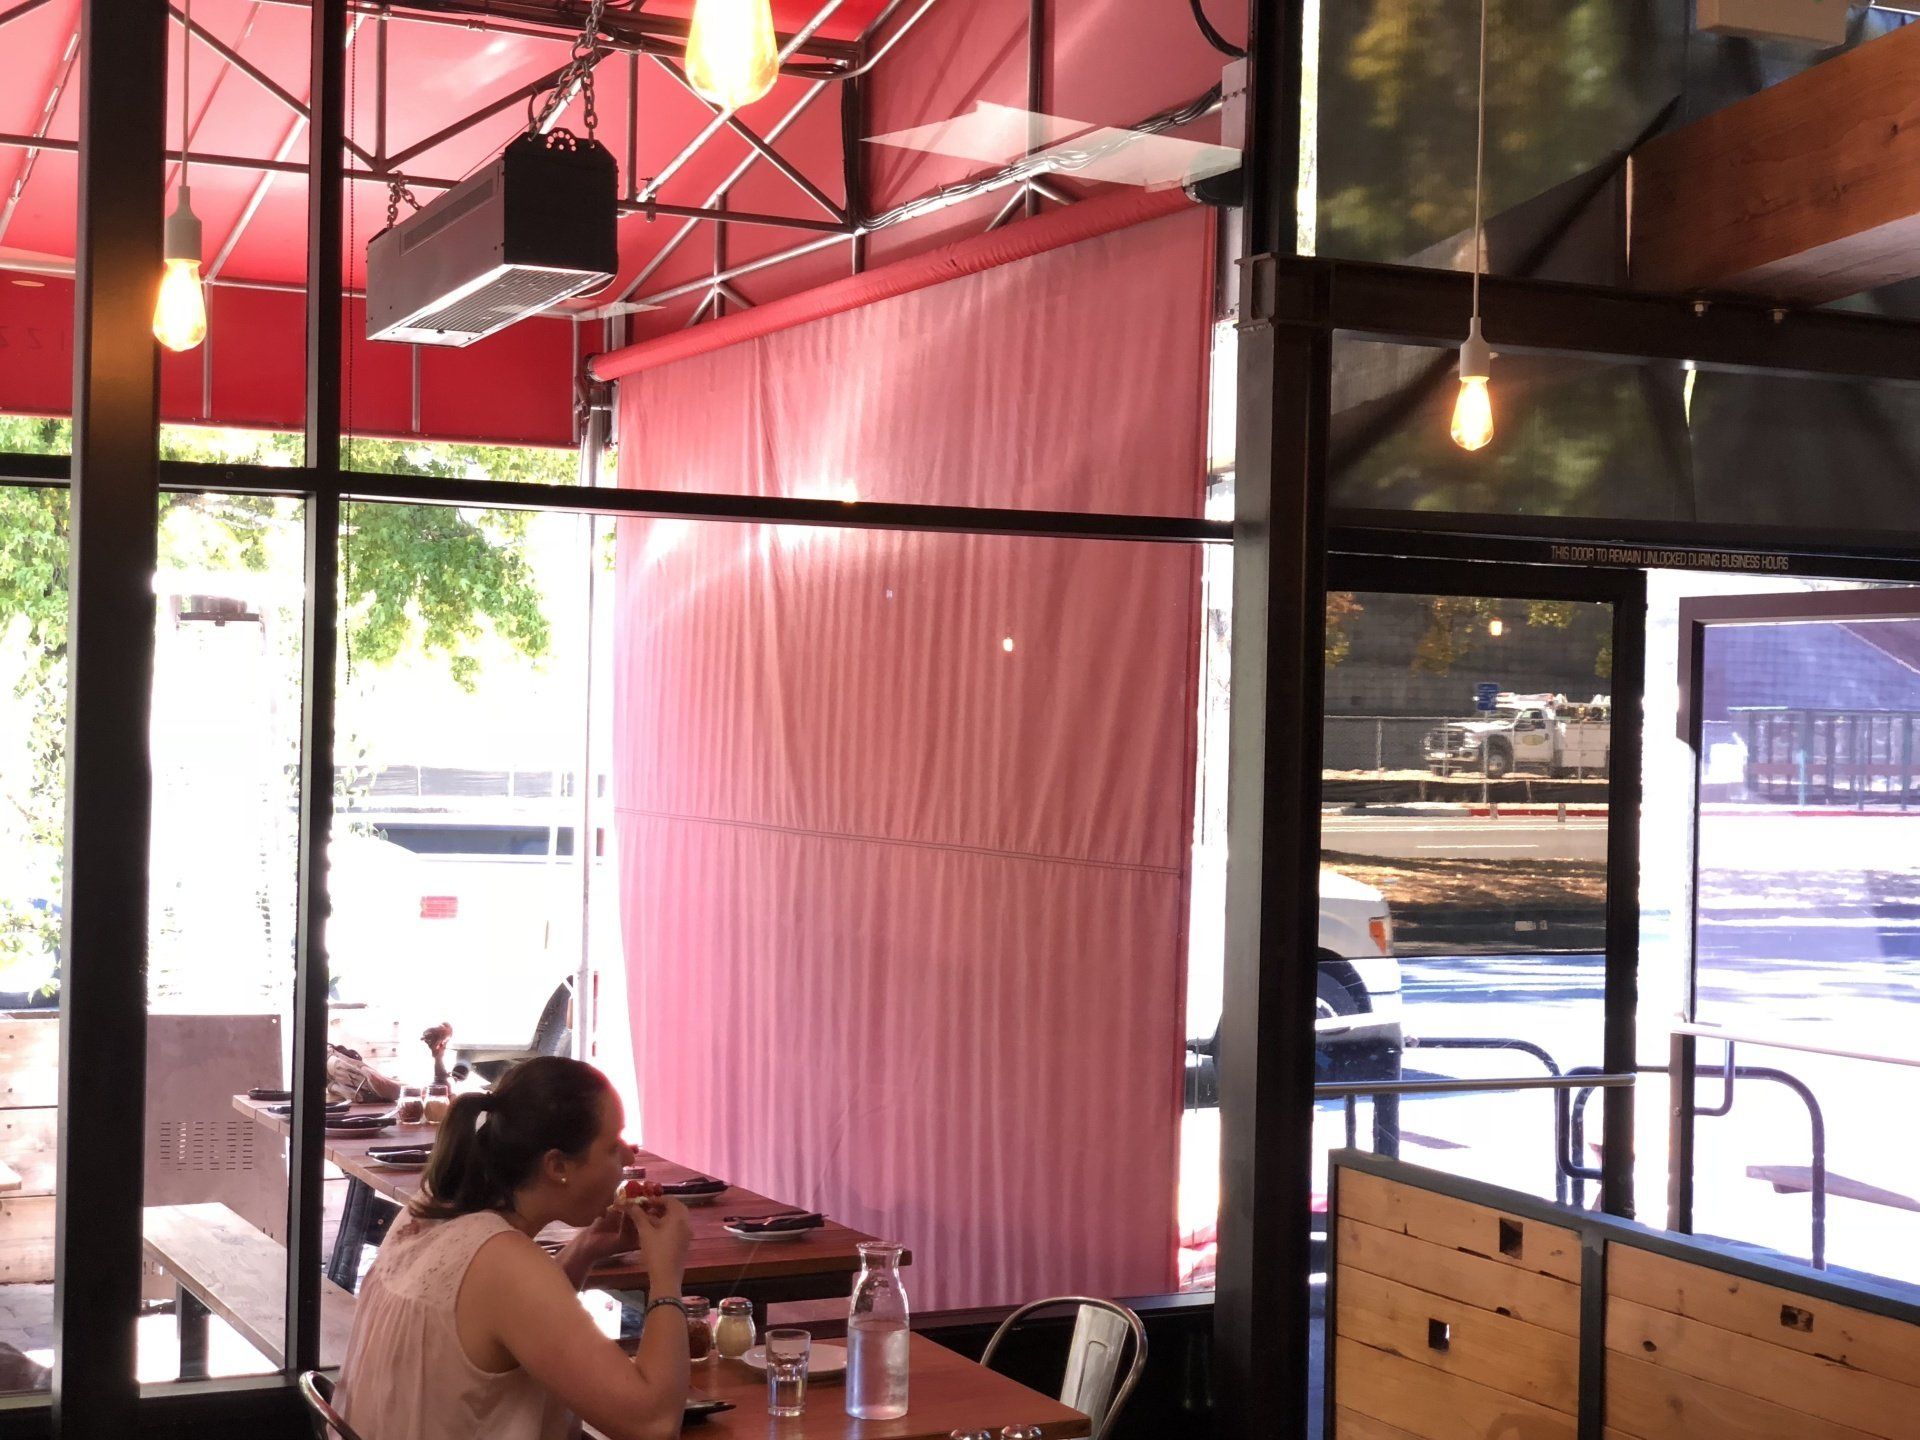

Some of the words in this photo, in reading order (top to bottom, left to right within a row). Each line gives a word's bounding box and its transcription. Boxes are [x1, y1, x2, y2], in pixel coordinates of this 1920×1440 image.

[1551, 545, 1569, 560] THIS
[1571, 547, 1594, 561] DOOR
[1596, 548, 1607, 561] TO
[1609, 549, 1641, 563] REMAIN
[1643, 551, 1687, 566] UNLOCKED
[1689, 553, 1720, 567] DURING
[1721, 554, 1760, 569] BUSINESS
[1761, 556, 1789, 570] HOURS
